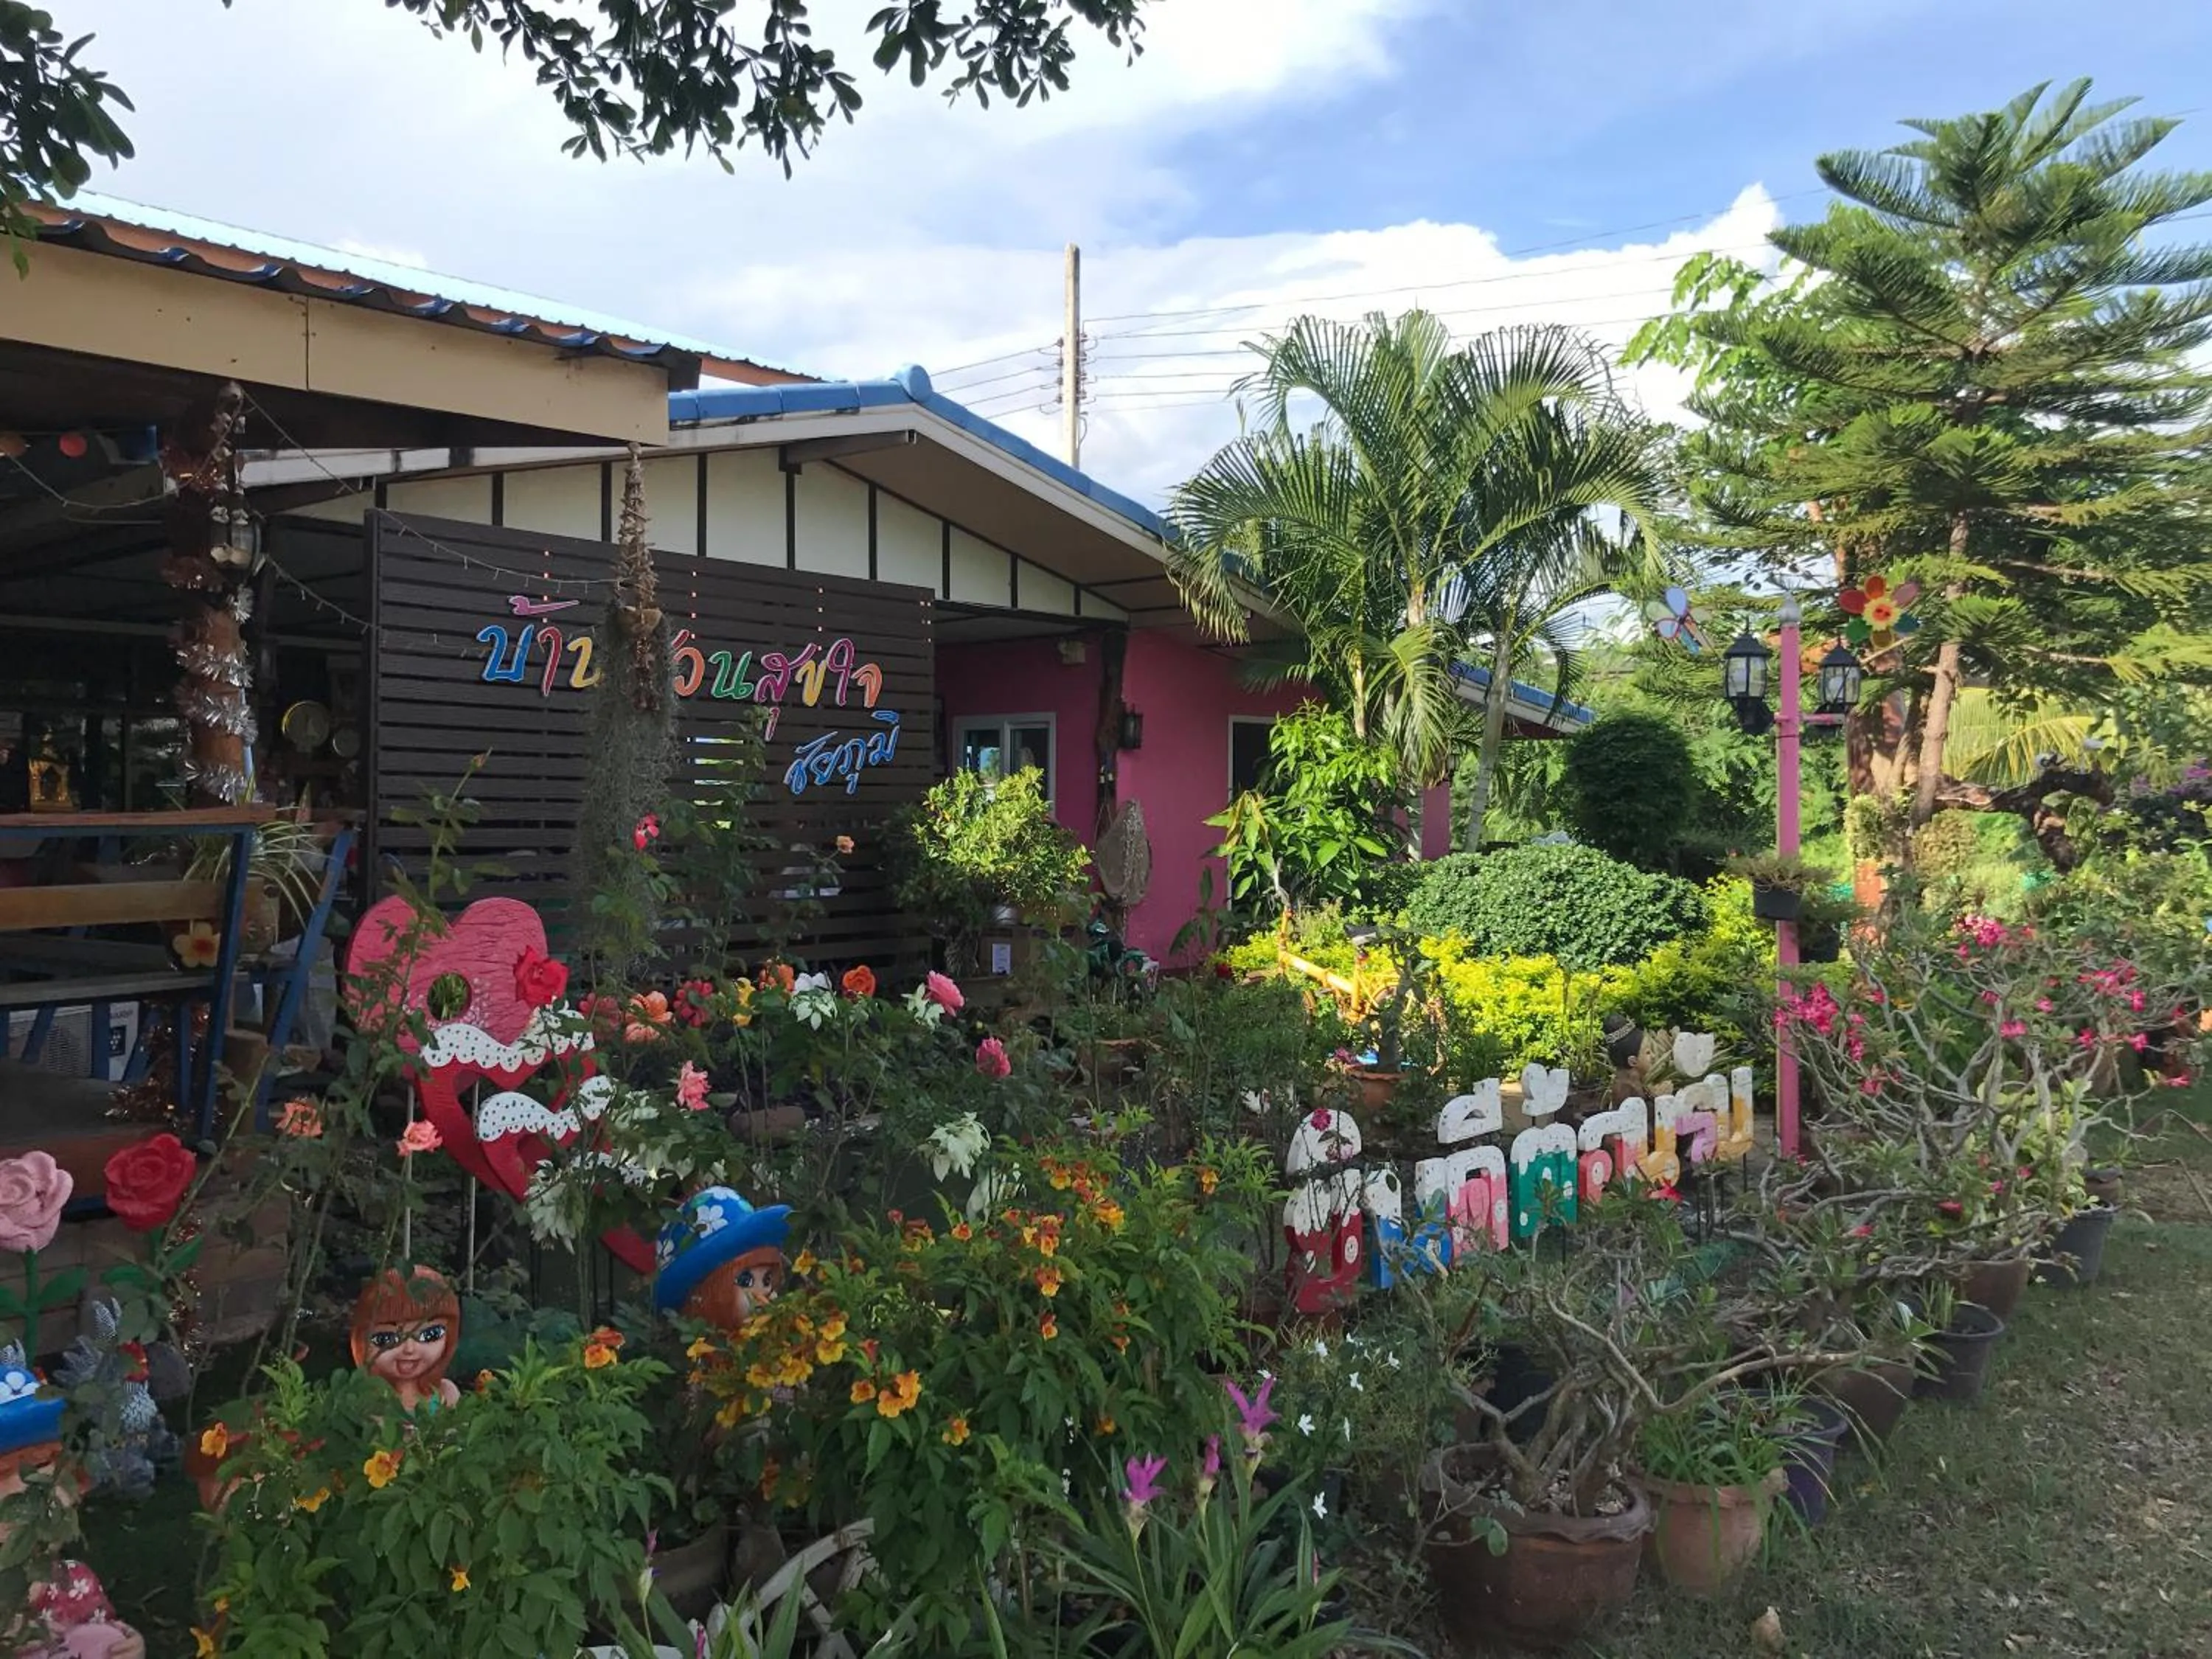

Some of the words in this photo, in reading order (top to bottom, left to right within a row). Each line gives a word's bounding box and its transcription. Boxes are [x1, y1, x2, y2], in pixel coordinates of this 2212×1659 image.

[476, 595, 883, 742] บ้านวนสุขใจ
[783, 710, 900, 794] ชัยภูมิ
